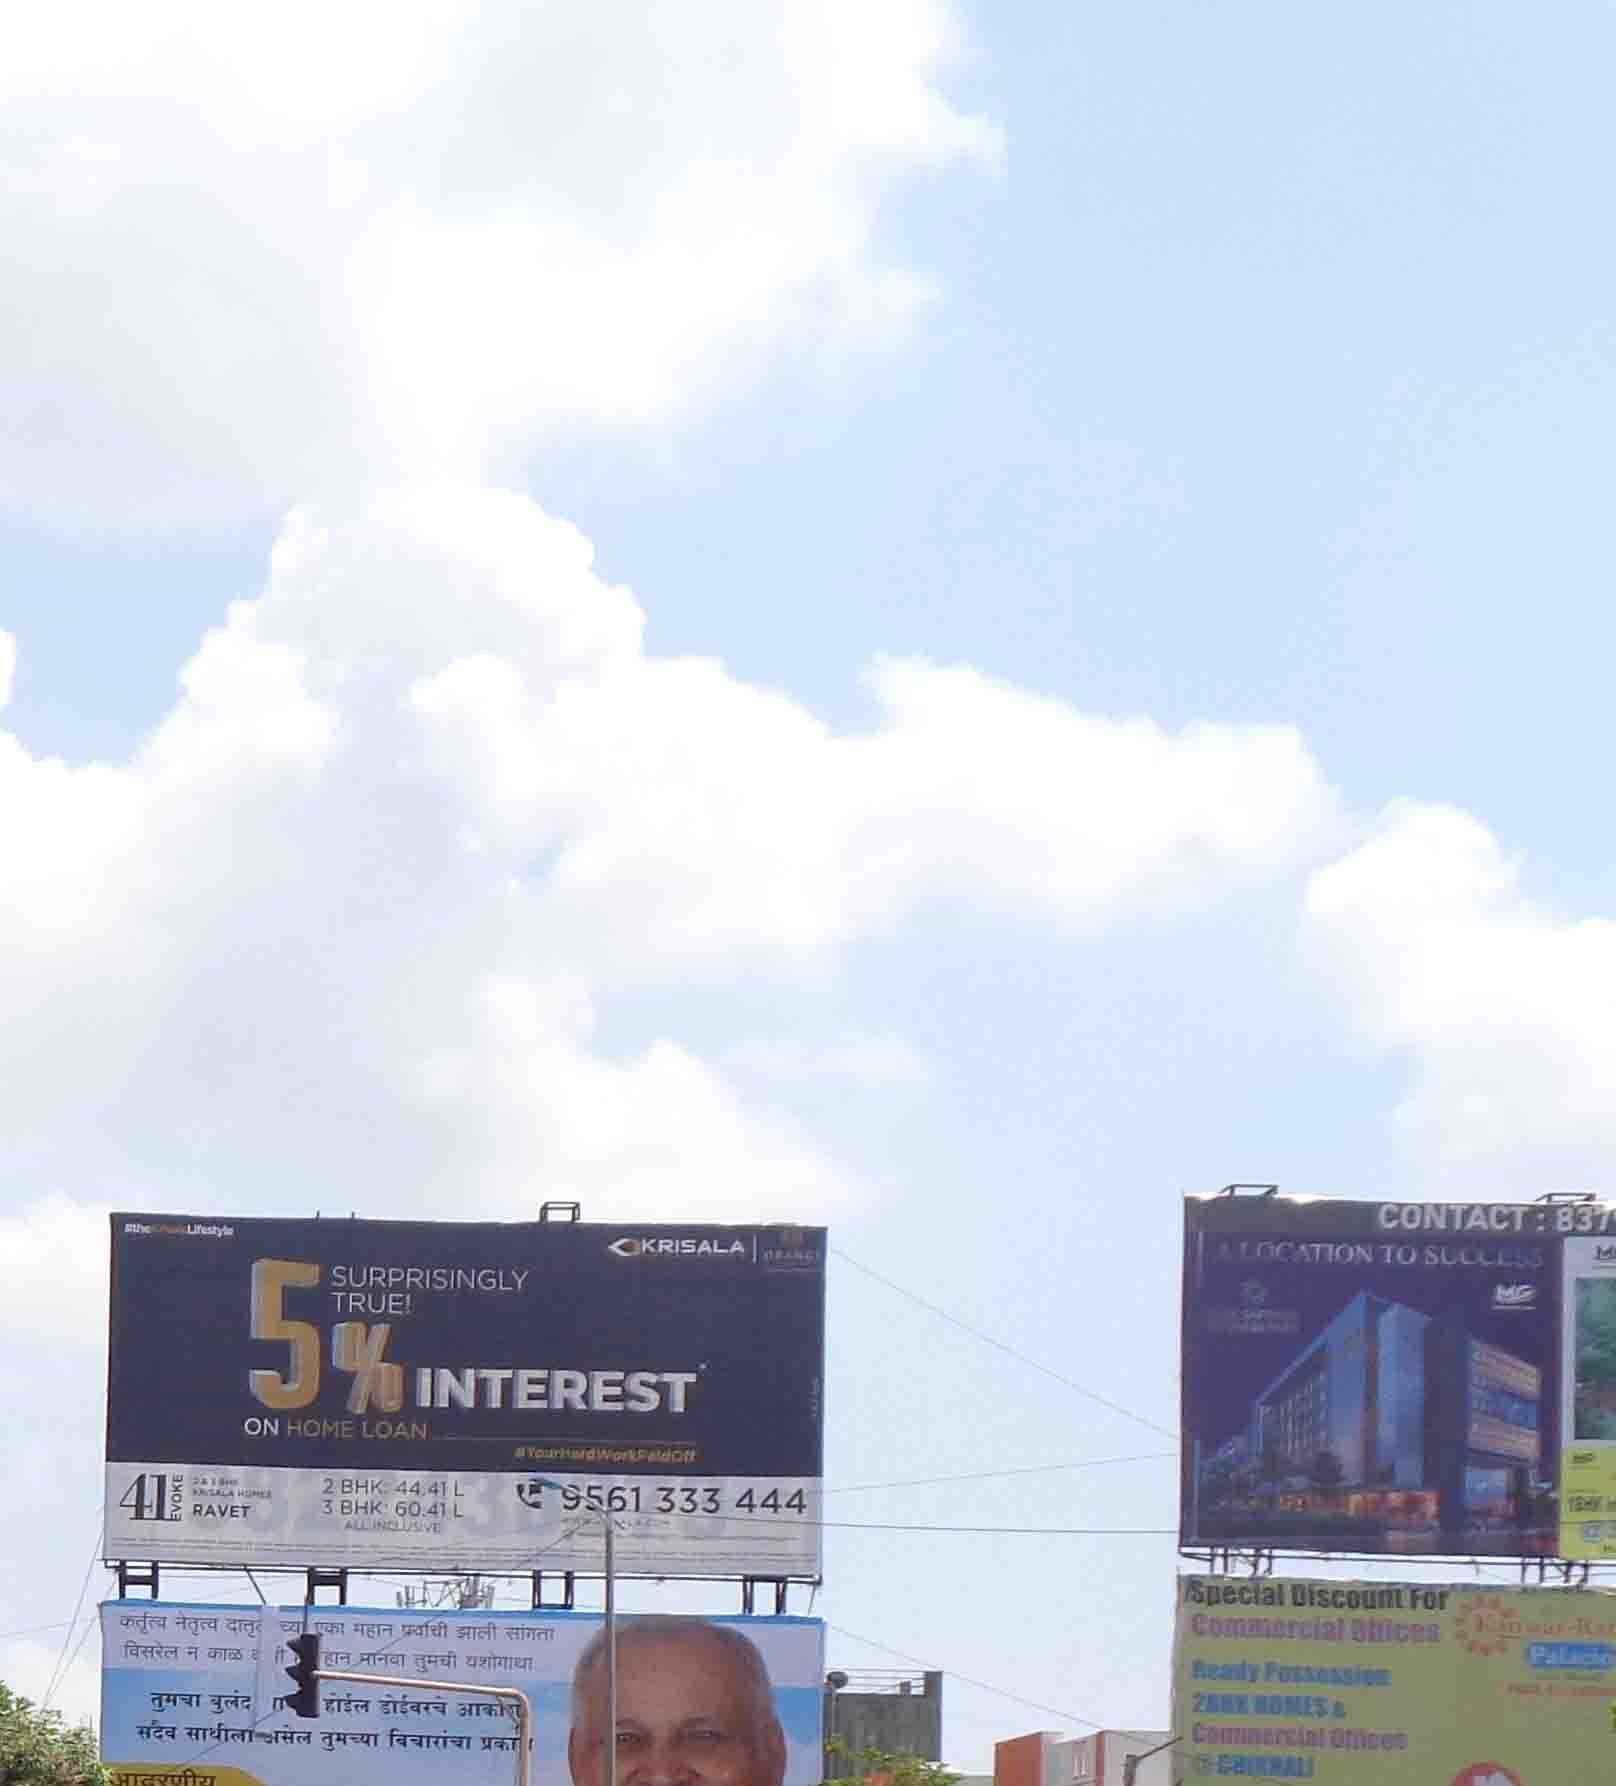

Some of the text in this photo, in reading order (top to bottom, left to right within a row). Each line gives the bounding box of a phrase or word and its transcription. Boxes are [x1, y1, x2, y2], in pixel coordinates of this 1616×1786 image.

[1377, 1203, 1526, 1231] CONTACT
[1556, 1206, 1616, 1232] 837
[641, 1238, 745, 1255] KRISALA
[1242, 1241, 1376, 1264] LOCATION
[1380, 1243, 1416, 1265] TO
[1424, 1245, 1545, 1268] SUCCESS
[330, 1265, 530, 1291] SURPRISINGLY
[330, 1291, 413, 1315] TRUE!
[243, 1416, 429, 1440] ON HOME LOAN
[170, 1473, 184, 1521] EVOKE
[321, 1478, 335, 1495] 2
[394, 1479, 449, 1498] 44.41
[453, 1480, 466, 1497] L
[561, 1484, 808, 1515] 9561 333 444
[192, 1503, 252, 1519] RAVET
[321, 1499, 334, 1516] 3
[394, 1501, 448, 1517] 60.41
[453, 1502, 465, 1518] L
[1189, 1579, 1451, 1610] Special Discount For
[352, 1622, 393, 1640] महान
[455, 1621, 498, 1642] झाली
[1191, 1613, 1345, 1642] Commercial
[123, 1639, 180, 1662] विसरेल
[185, 1647, 202, 1662] न
[413, 1651, 458, 1674] तुमची
[149, 1690, 202, 1713] तुमचा
[319, 1730, 380, 1753] तुमच्या
